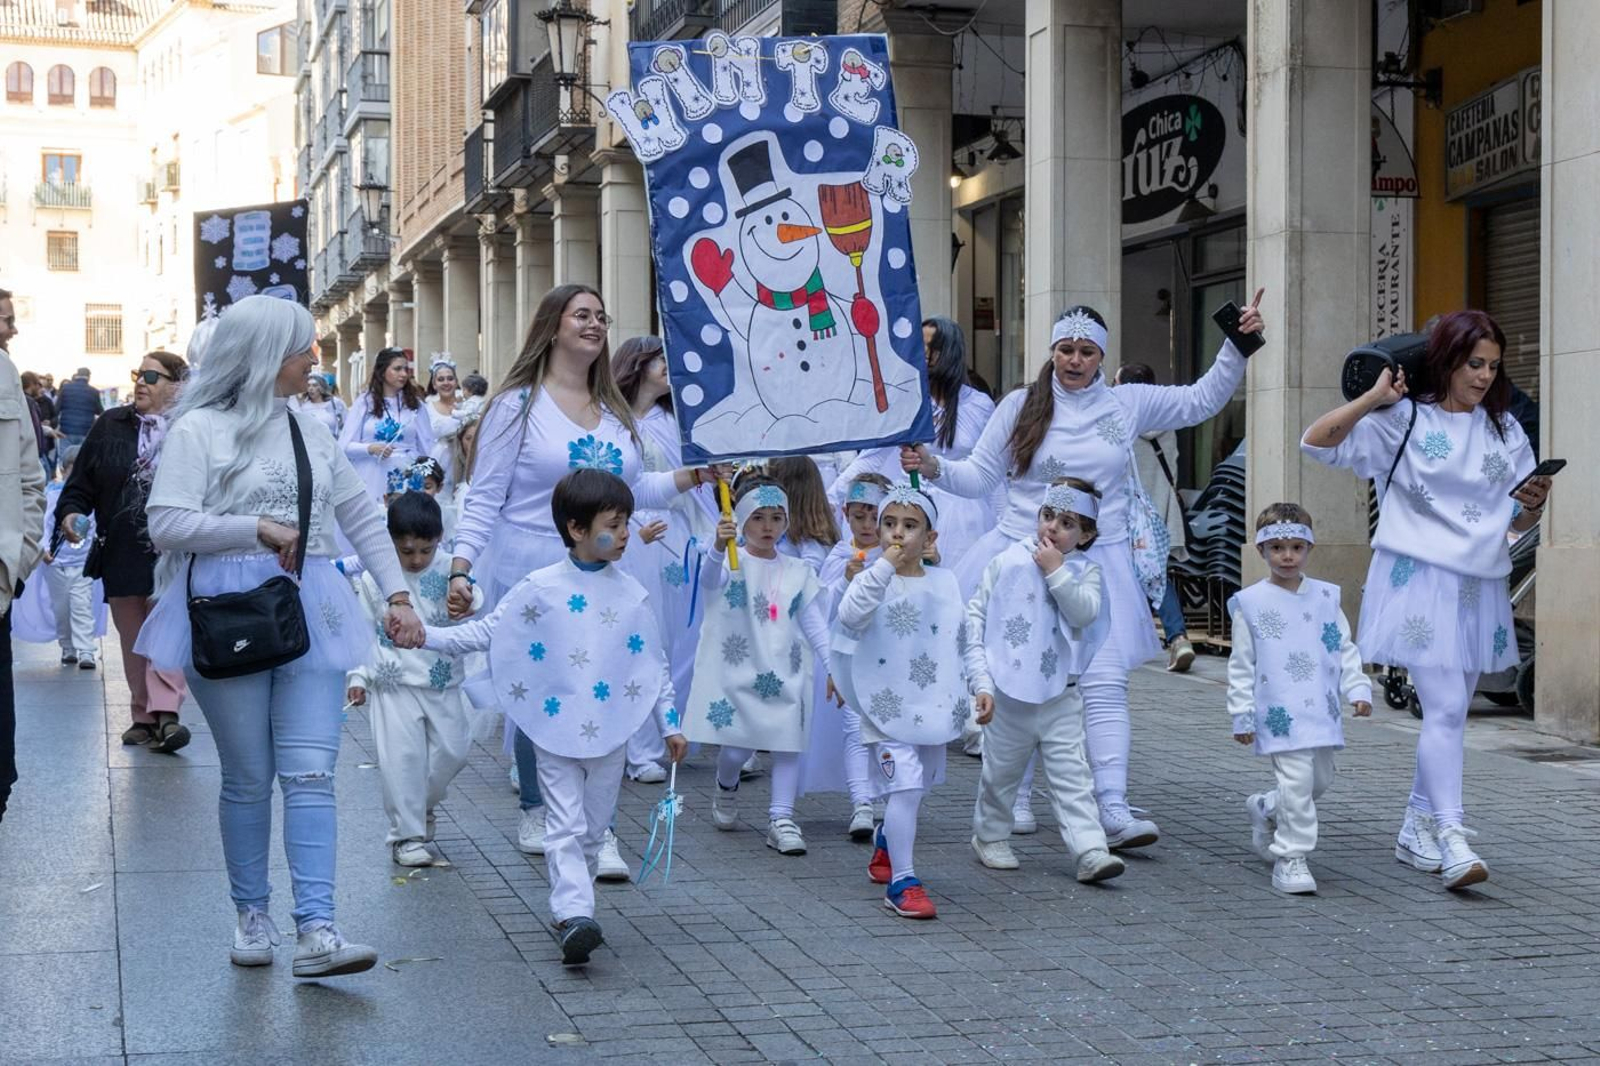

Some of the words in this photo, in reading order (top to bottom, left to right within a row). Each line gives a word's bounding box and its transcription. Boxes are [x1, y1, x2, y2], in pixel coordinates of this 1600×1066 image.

[607, 33, 919, 203] WINTER
[1149, 110, 1182, 139] Chica
[1449, 94, 1495, 136] CAFETERIA
[1448, 109, 1519, 169] CAMPANAS
[1475, 144, 1518, 180] SALON
